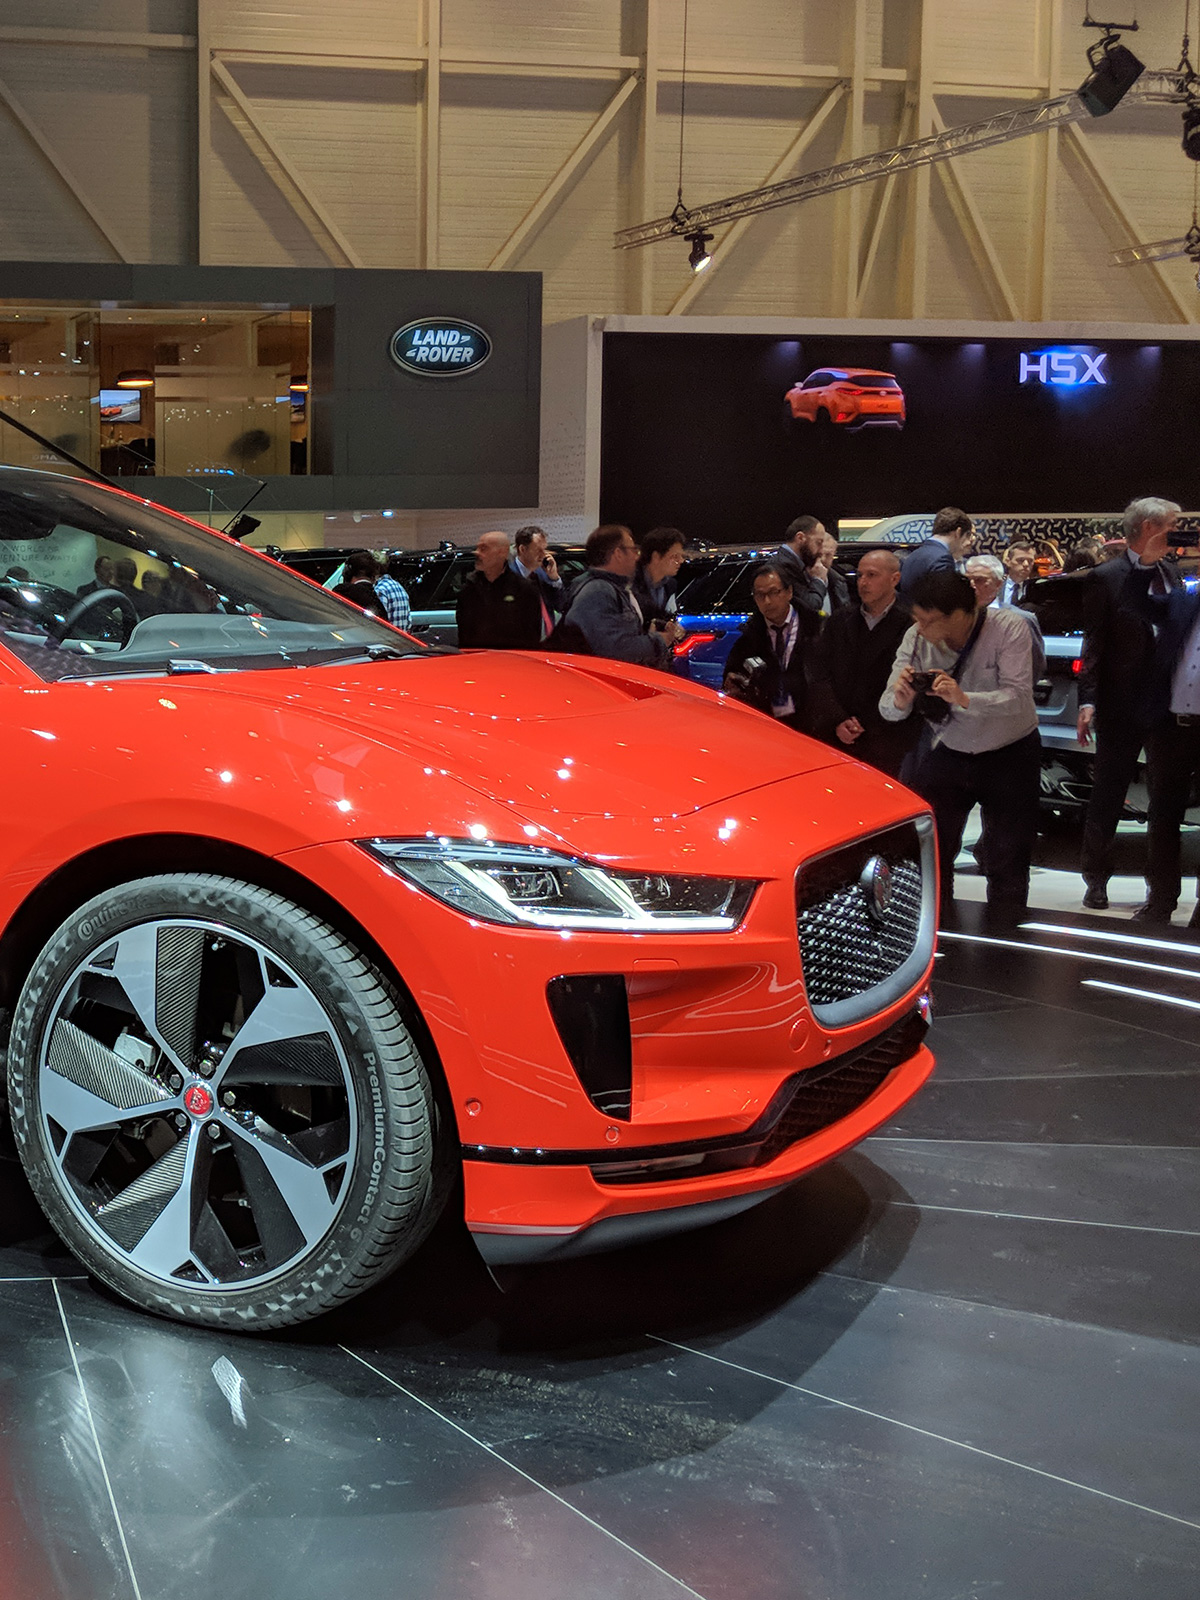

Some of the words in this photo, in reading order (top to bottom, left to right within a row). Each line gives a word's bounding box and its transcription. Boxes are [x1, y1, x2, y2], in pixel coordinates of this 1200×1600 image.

[412, 330, 460, 346] LAND
[415, 346, 475, 363] ROVER
[356, 1052, 387, 1225] PremiumContact
[349, 1226, 363, 1243] 6
